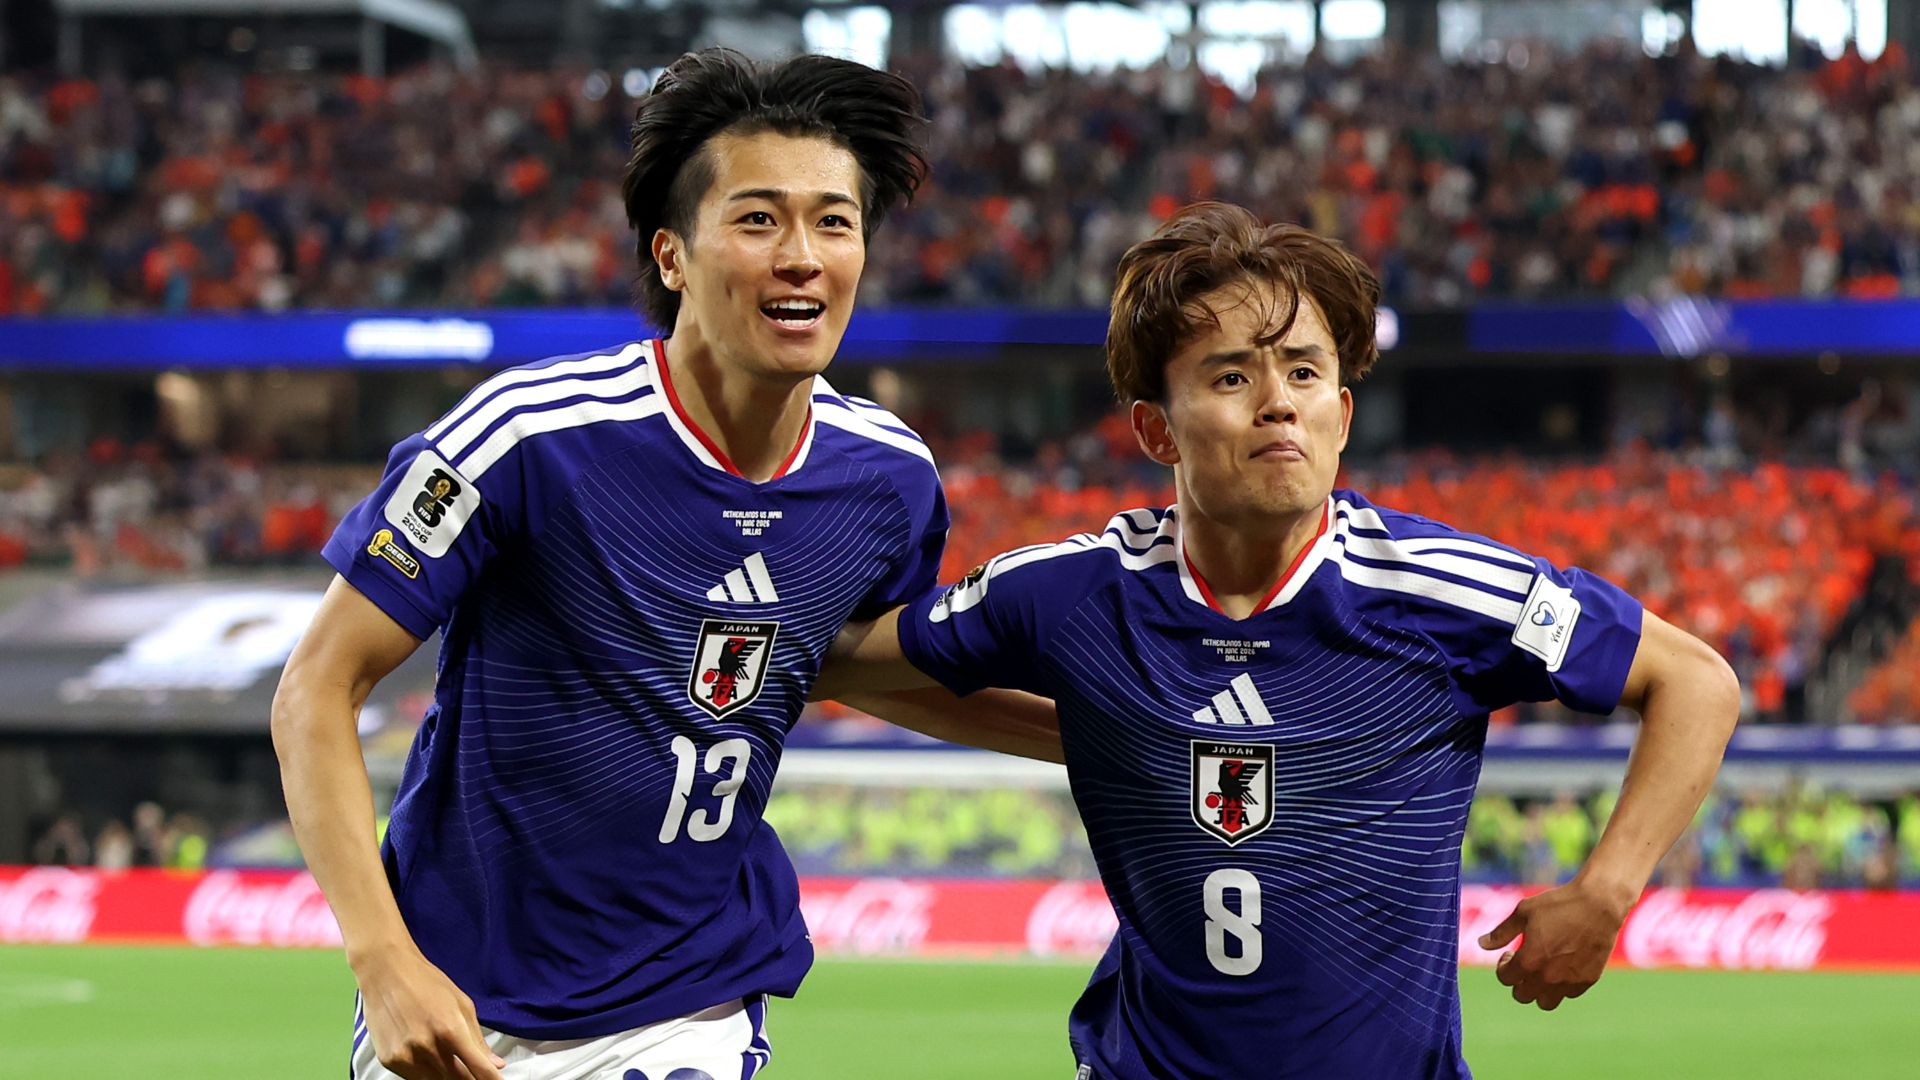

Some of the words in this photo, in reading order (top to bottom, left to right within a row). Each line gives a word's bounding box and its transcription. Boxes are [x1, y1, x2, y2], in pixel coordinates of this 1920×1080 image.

[417, 506, 432, 522] FIFA
[722, 510, 759, 519] NETHERLANDS
[768, 511, 783, 519] JAPAN
[402, 516, 429, 544] 2026
[406, 511, 422, 528] WORLD
[420, 526, 433, 536] CUP
[742, 519, 755, 527] JUNE
[756, 520, 770, 528] 2026
[742, 528, 762, 536] DALLAS
[385, 544, 416, 569] DEBUT
[720, 624, 759, 633] JAPAN
[1552, 625, 1564, 643] FIFA
[1202, 638, 1242, 647] NETHERLANDS
[1252, 640, 1270, 648] JAPAN
[1224, 647, 1239, 655] JUNE
[1240, 648, 1256, 656] 2026
[705, 685, 738, 700] JFA
[1212, 745, 1254, 755] JAPAN
[658, 735, 751, 844] 13
[1213, 809, 1251, 826] JFA
[1203, 868, 1263, 976] 8
